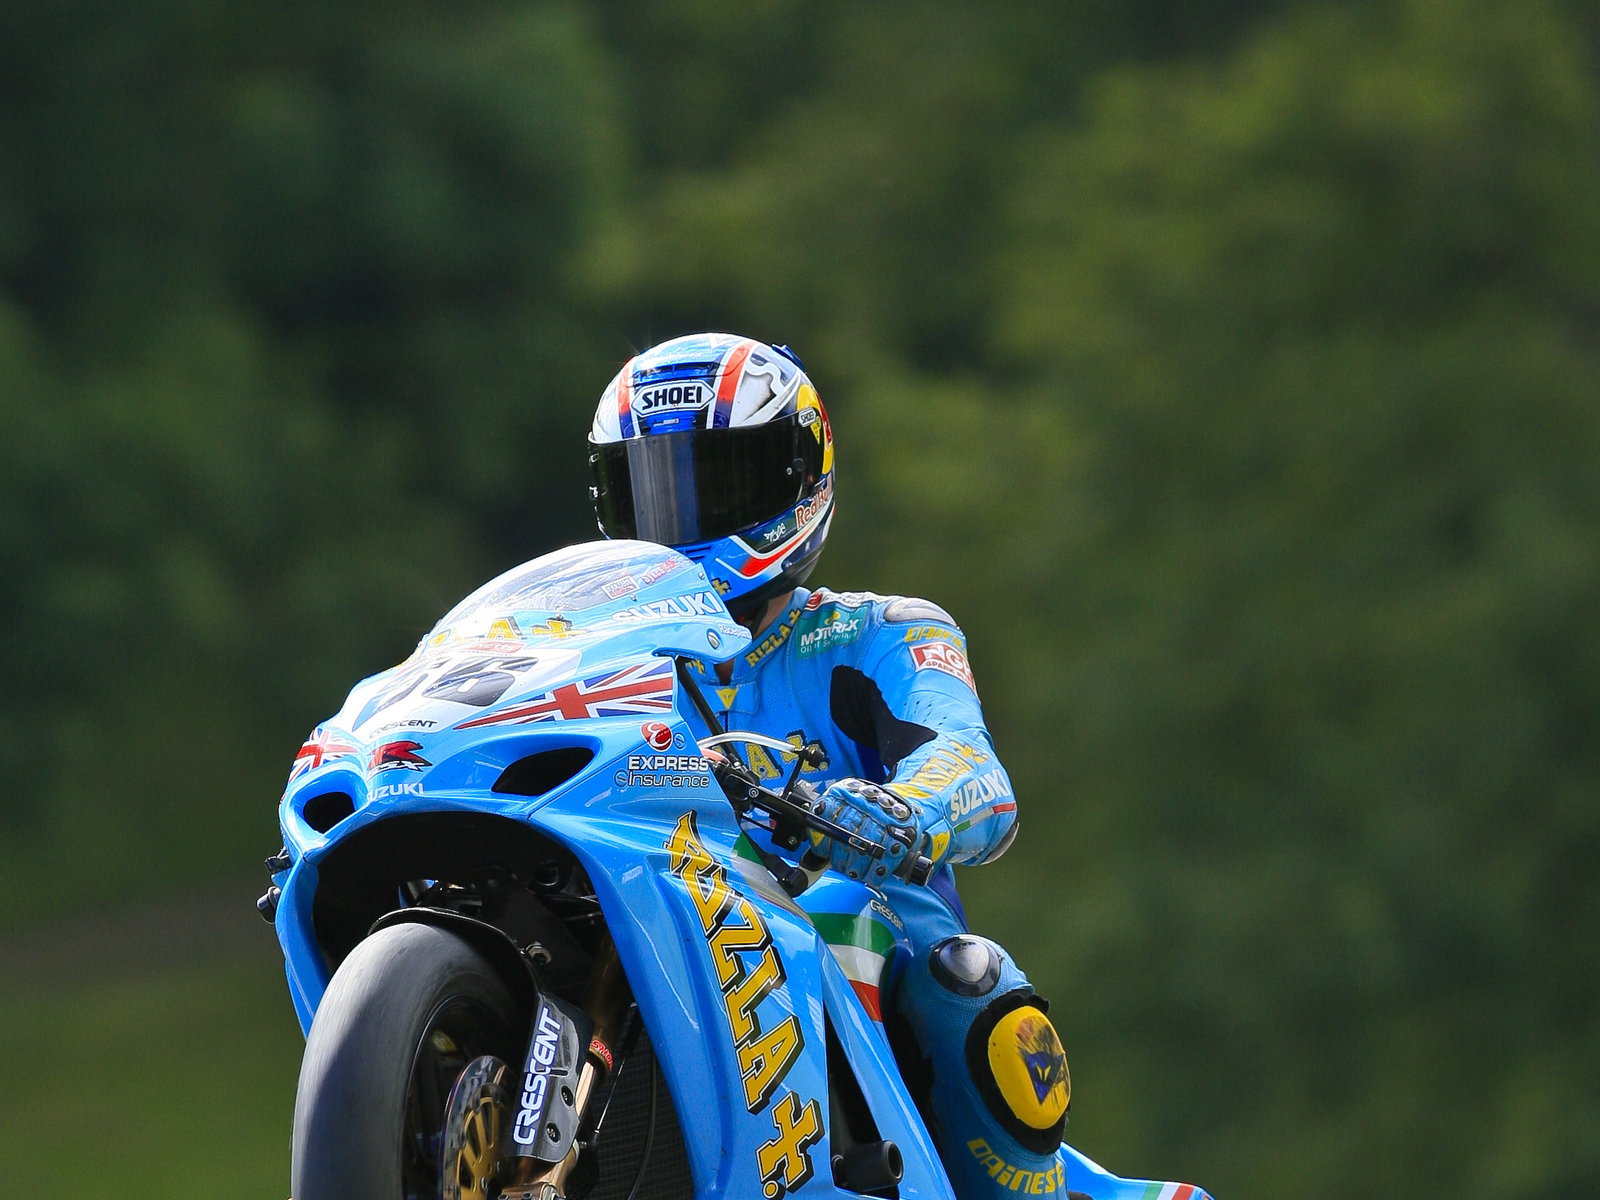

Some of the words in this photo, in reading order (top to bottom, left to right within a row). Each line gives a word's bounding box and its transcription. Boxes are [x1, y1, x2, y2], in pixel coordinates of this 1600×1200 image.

[641, 386, 703, 410] SHOEI
[610, 591, 726, 620] SUZUKI
[628, 755, 710, 771] EXPRESS
[628, 771, 710, 787] Insurance
[950, 768, 1012, 822] SUZUKI
[513, 1007, 561, 1145] CRESCENT
